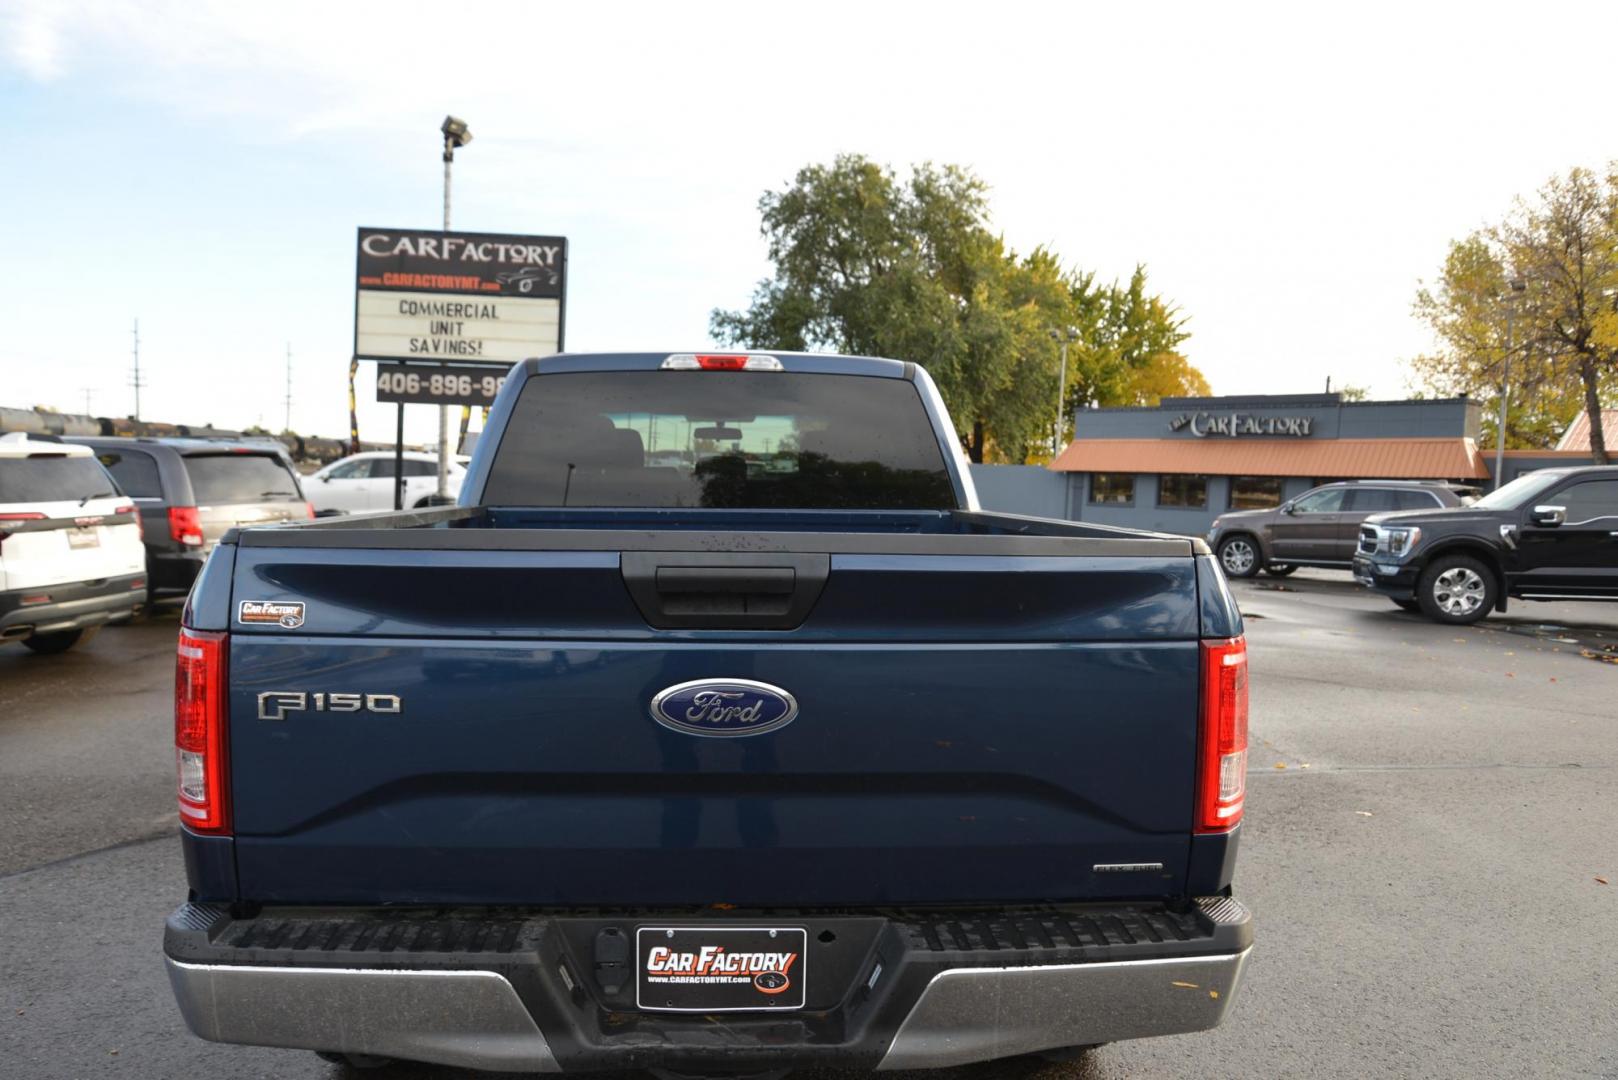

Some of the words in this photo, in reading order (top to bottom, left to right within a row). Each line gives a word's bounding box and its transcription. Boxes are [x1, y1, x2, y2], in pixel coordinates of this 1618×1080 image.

[399, 299, 499, 320] COMMERCIAL
[430, 320, 465, 337] UNIT
[409, 338, 483, 355] SAVINGS!
[685, 690, 764, 723] Ford
[647, 946, 695, 973] CAR
[696, 946, 796, 973] FACTORY
[648, 975, 751, 985] www.CARFACTORYMT.com
